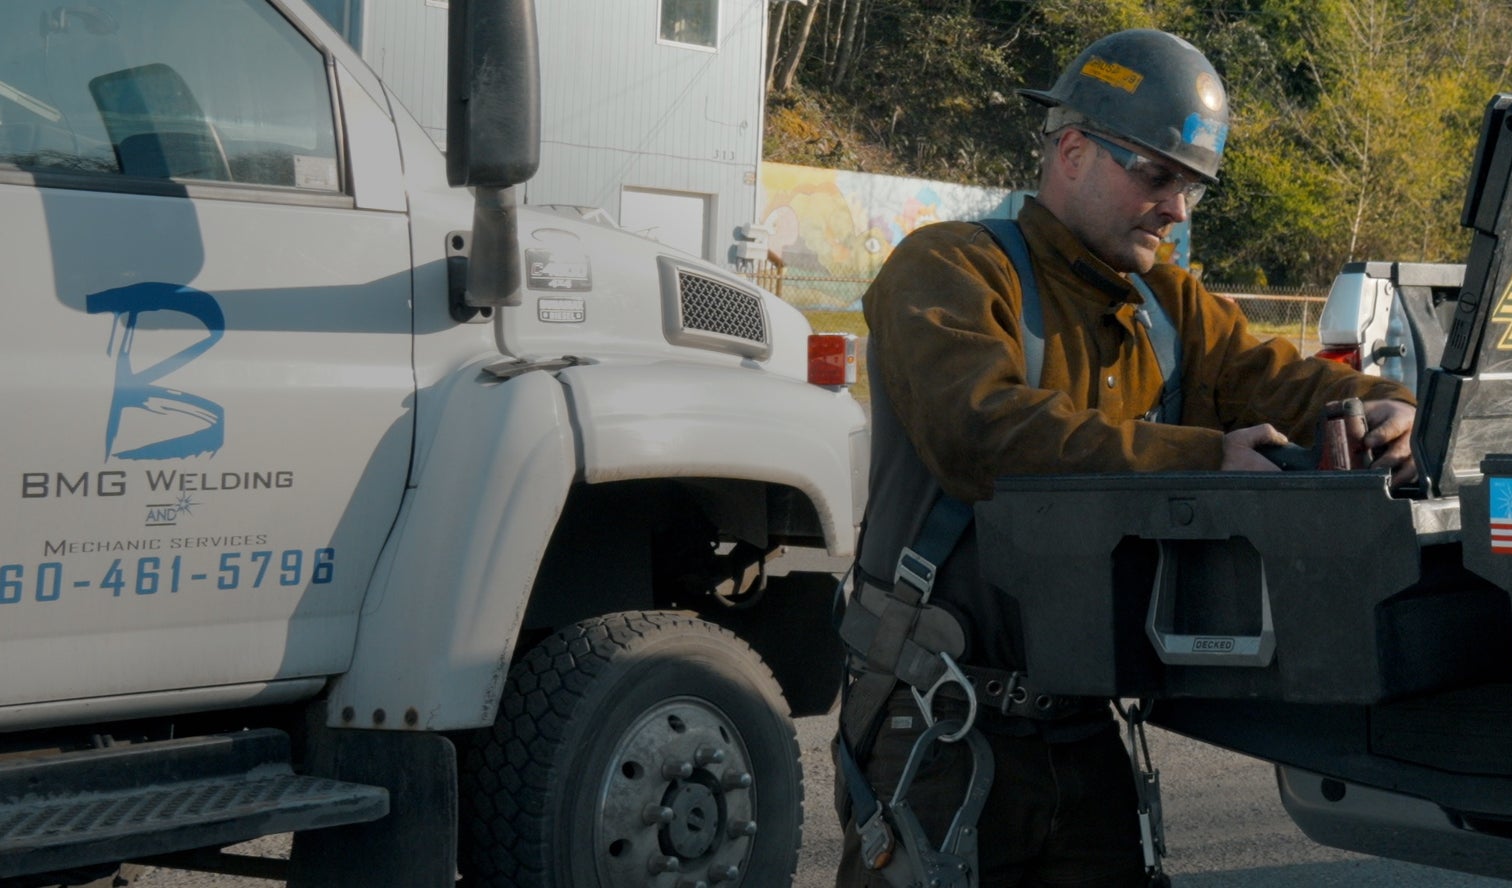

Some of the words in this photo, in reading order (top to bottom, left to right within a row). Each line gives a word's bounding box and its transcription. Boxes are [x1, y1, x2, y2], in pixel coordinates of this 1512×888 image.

[21, 470, 127, 498] BMG
[145, 469, 294, 492] WELDING
[145, 508, 177, 522] AND
[44, 538, 162, 557] MECHANIC
[170, 534, 268, 549] SERVICES
[1195, 640, 1232, 649] DECKED
